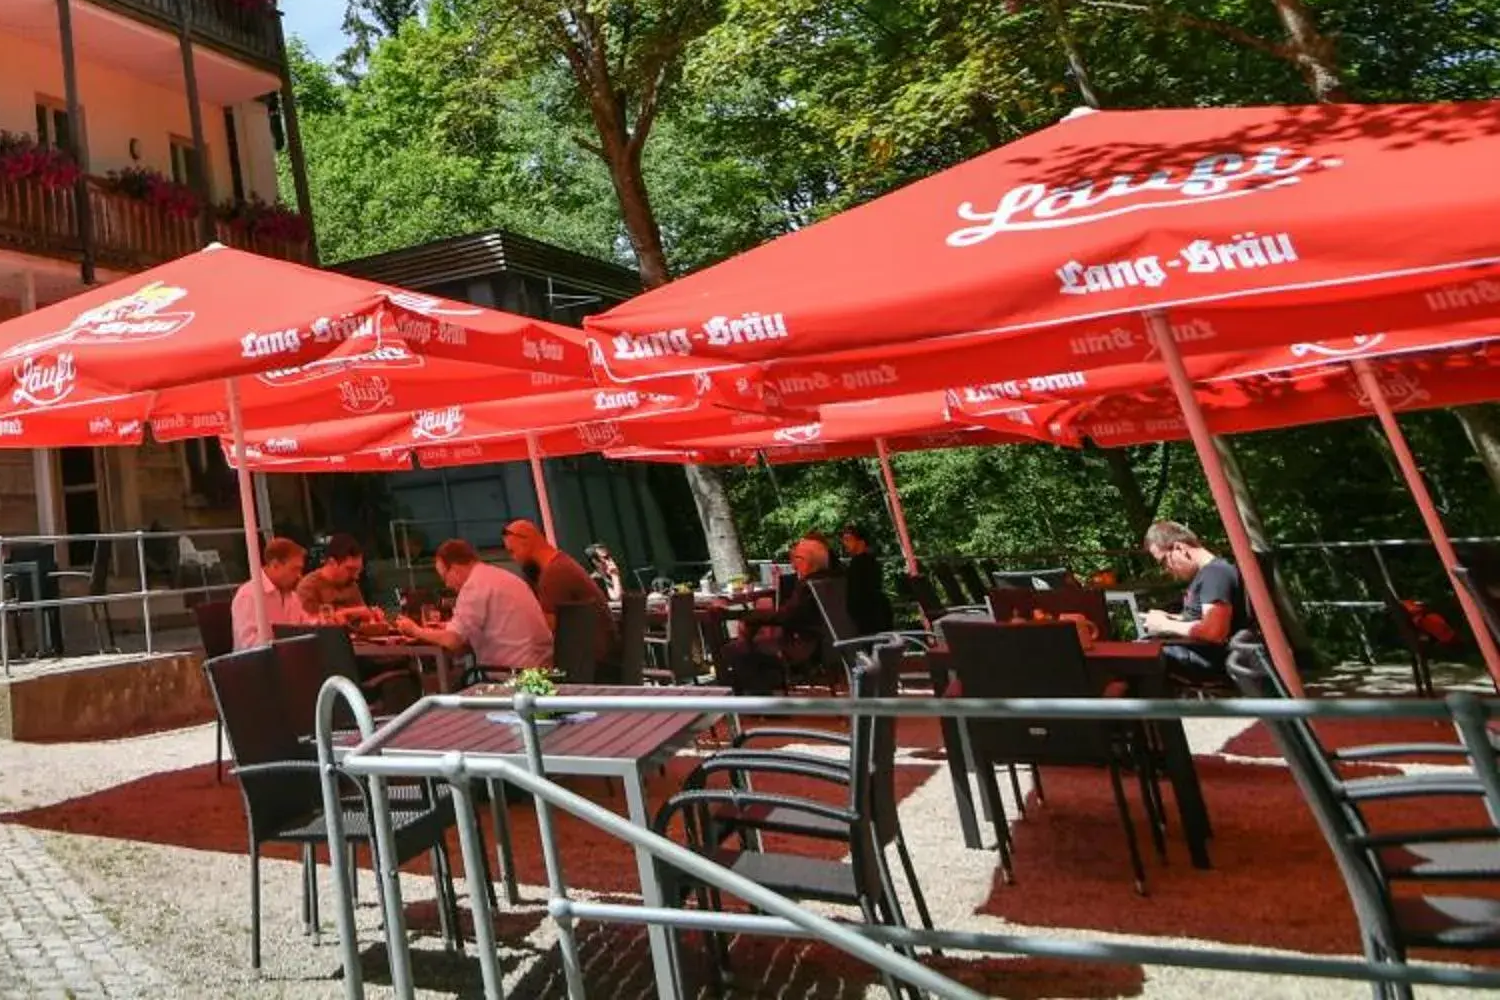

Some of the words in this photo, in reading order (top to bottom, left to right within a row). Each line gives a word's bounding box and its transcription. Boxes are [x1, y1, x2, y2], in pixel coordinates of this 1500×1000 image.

[1055, 232, 1299, 295] Lang-Bräu
[240, 312, 373, 357] Lang-Bräu
[612, 312, 788, 360] Lang-Bräu
